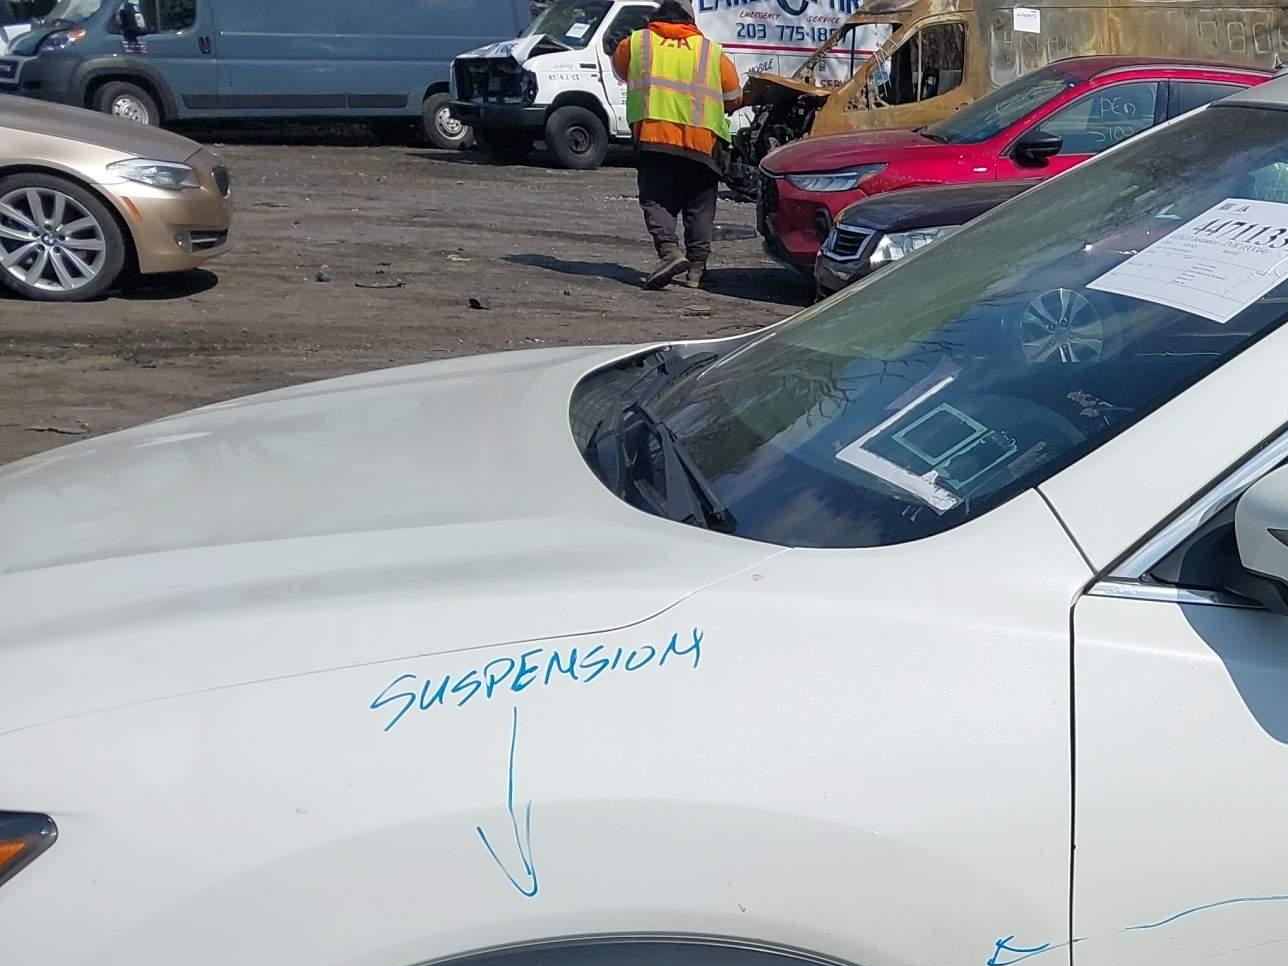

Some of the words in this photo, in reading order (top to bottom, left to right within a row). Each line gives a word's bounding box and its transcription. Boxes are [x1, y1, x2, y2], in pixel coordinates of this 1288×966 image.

[738, 10, 781, 20] EMERGENCY
[806, 15, 841, 25] SERVICE
[735, 22, 767, 40] 203
[775, 24, 846, 44] 775-18
[369, 626, 704, 732] SUSPENSION
